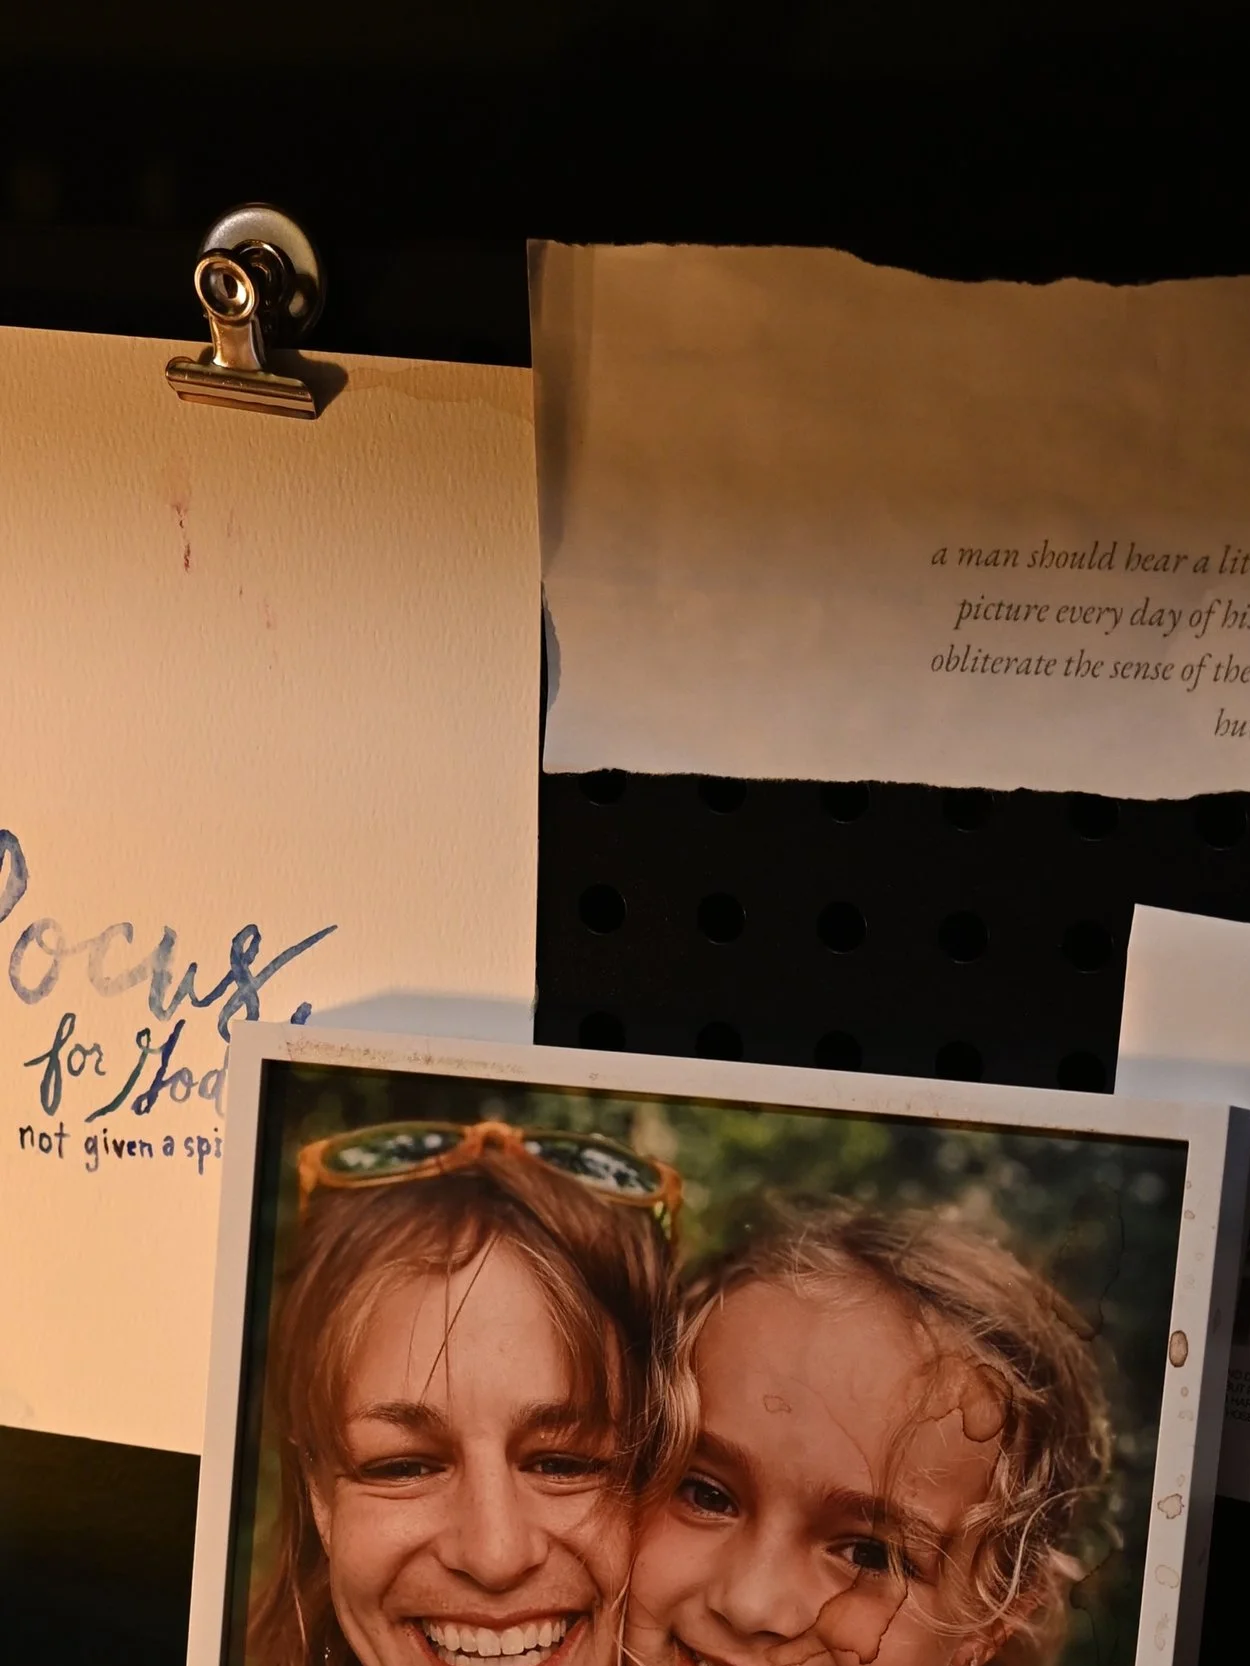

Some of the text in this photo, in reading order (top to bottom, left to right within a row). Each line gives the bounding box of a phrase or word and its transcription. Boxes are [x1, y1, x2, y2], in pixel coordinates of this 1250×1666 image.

[931, 548, 947, 565] a
[959, 548, 1019, 567] man
[1027, 539, 1118, 570] should
[1125, 542, 1188, 573] hear
[1193, 556, 1209, 573] a
[954, 595, 1049, 630] picture
[1056, 605, 1123, 635] every
[1130, 597, 1182, 637] day
[1189, 599, 1221, 638] of
[931, 644, 1057, 676] obliterate
[1064, 649, 1104, 678] the
[1109, 662, 1174, 680] sense
[1181, 653, 1212, 692] of
[0, 829, 338, 1043] ocus
[24, 1013, 106, 1116] for
[19, 1122, 70, 1159] not
[84, 1128, 153, 1172] given
[162, 1135, 175, 1157] a
